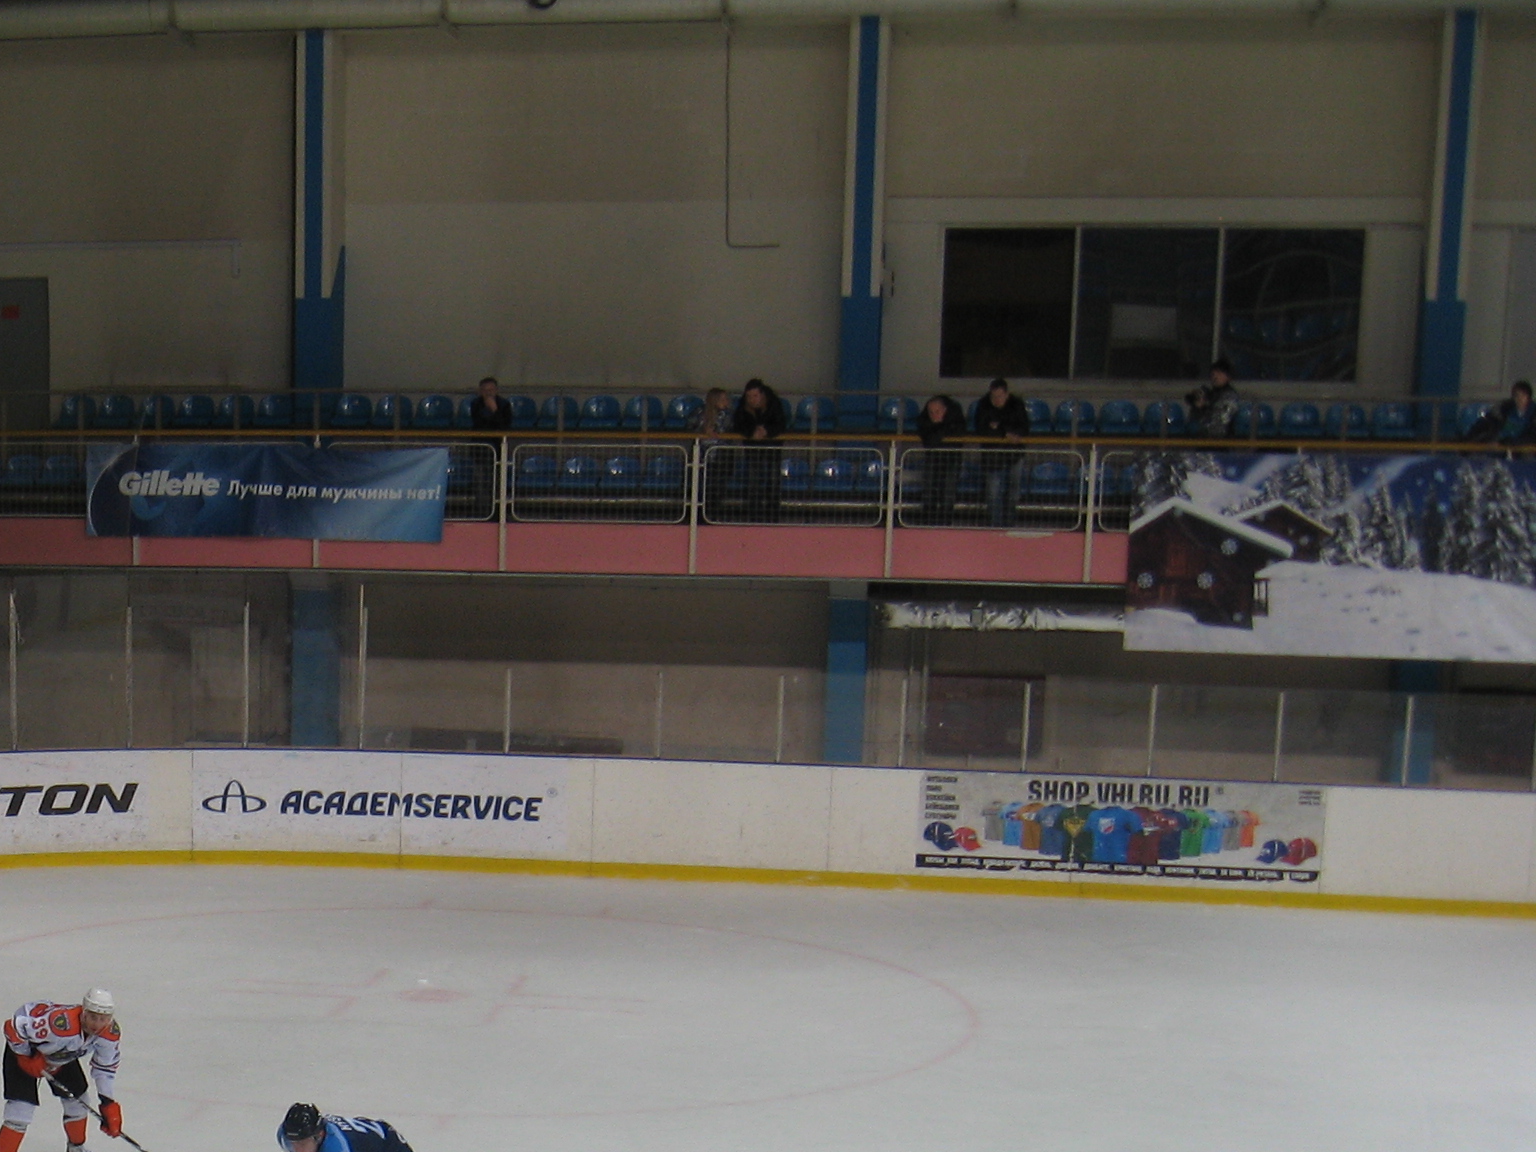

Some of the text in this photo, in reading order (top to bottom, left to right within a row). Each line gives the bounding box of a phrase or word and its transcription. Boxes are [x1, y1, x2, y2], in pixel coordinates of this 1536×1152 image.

[118, 469, 220, 497] Gillette
[227, 480, 283, 497] Лучше
[286, 484, 317, 500] для
[321, 485, 403, 504] мужчины
